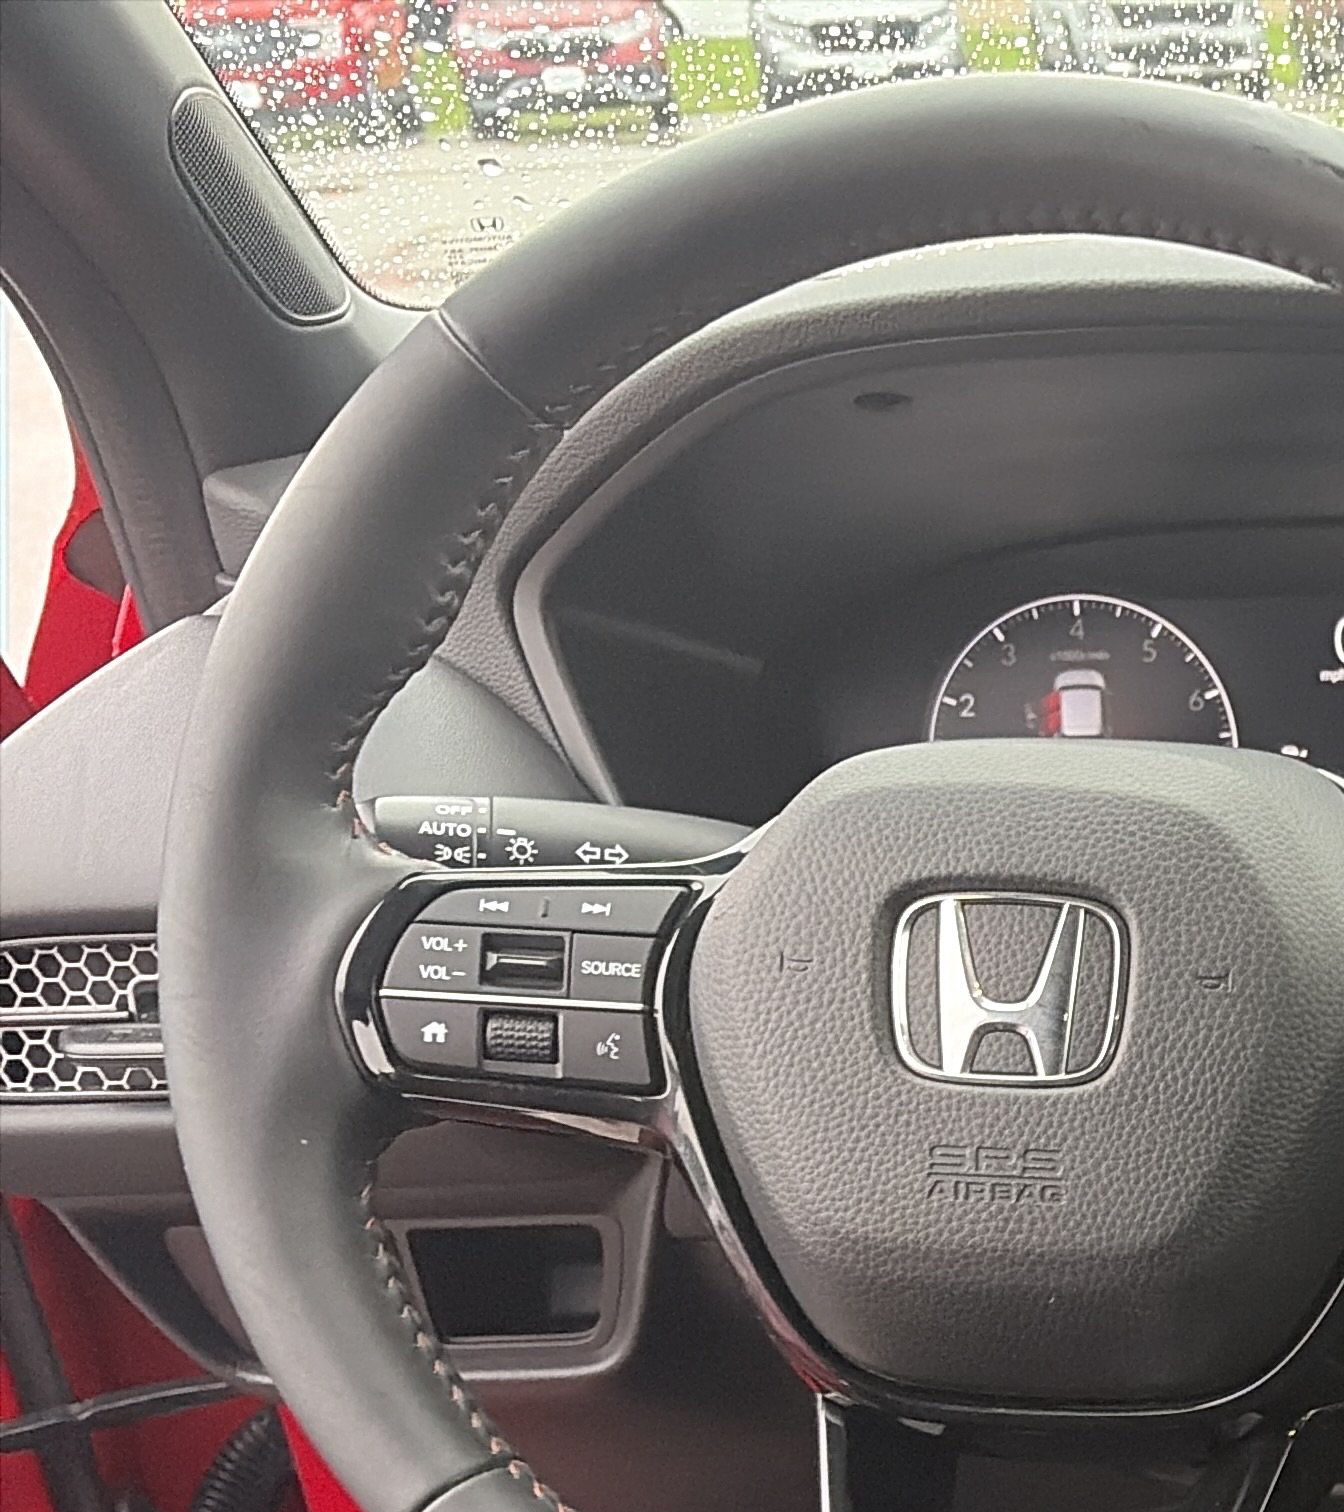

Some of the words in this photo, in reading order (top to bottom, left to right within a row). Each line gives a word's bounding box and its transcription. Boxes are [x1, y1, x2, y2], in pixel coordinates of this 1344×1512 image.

[1069, 618, 1085, 641] 4
[1001, 643, 1017, 667] 3
[1142, 639, 1158, 663] 5
[958, 692, 976, 718] 2
[1188, 689, 1205, 712] 6
[435, 804, 473, 815] OFF
[418, 820, 473, 838] AUTO
[420, 935, 469, 953] VOL+
[580, 960, 642, 978] SOURCE
[928, 1144, 1064, 1179] SRS
[927, 1179, 1068, 1203] AIRBAG
